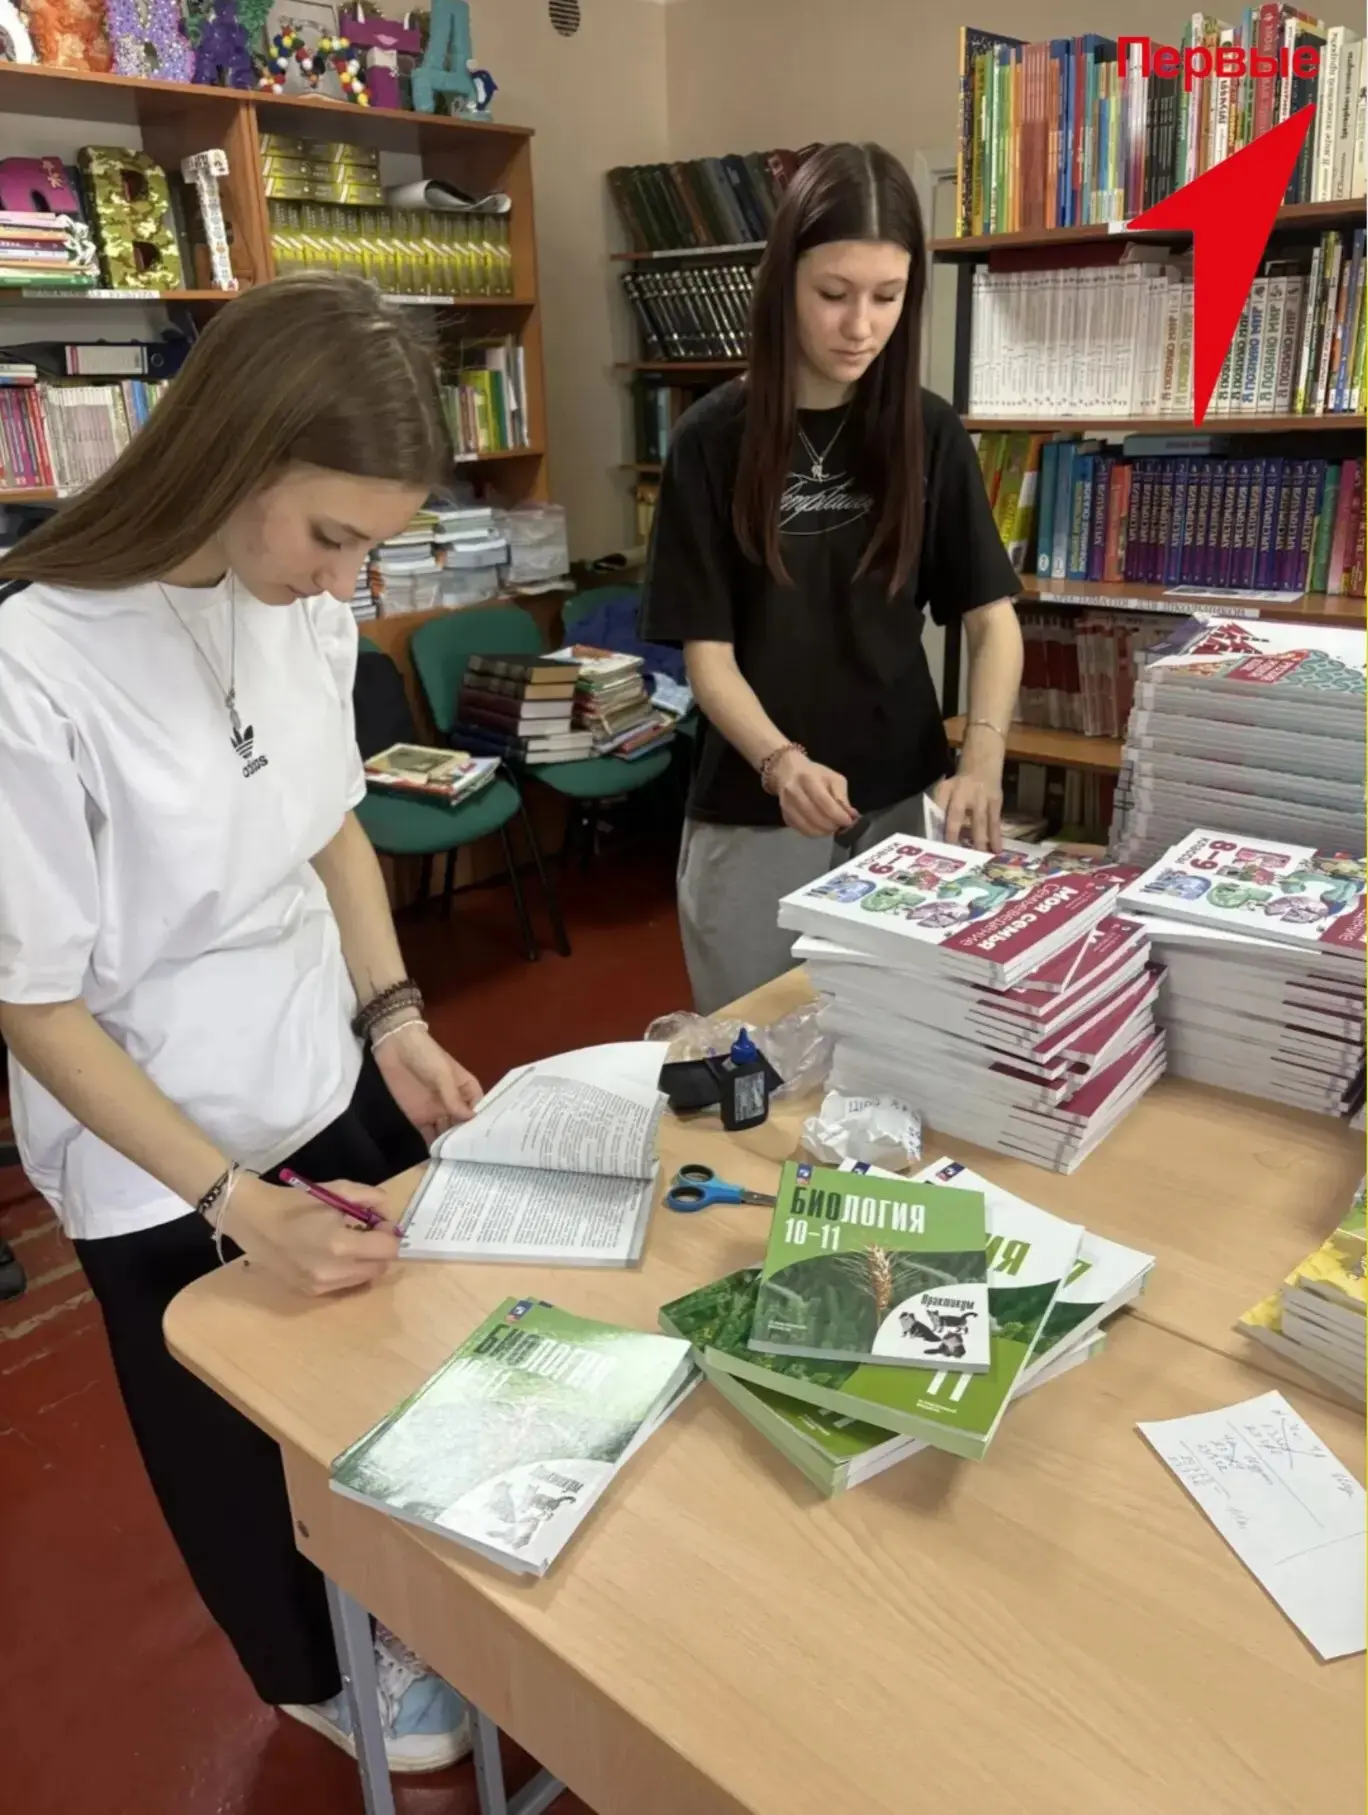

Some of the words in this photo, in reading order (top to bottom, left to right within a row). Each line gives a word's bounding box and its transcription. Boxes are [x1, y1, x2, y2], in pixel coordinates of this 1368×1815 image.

[1248, 305, 1262, 335] МИР
[1267, 304, 1280, 333] МИР
[1244, 338, 1259, 390] ПОЗНАЮ
[1261, 336, 1277, 389] ПОЗНАЮ
[960, 883, 1060, 946] Семьеведение
[1034, 886, 1079, 913] Моя
[977, 913, 1038, 950] семья
[790, 1185, 926, 1234] БИОЛОГИЯ
[784, 1218, 840, 1251] 10-11
[921, 1292, 975, 1312] Практикум
